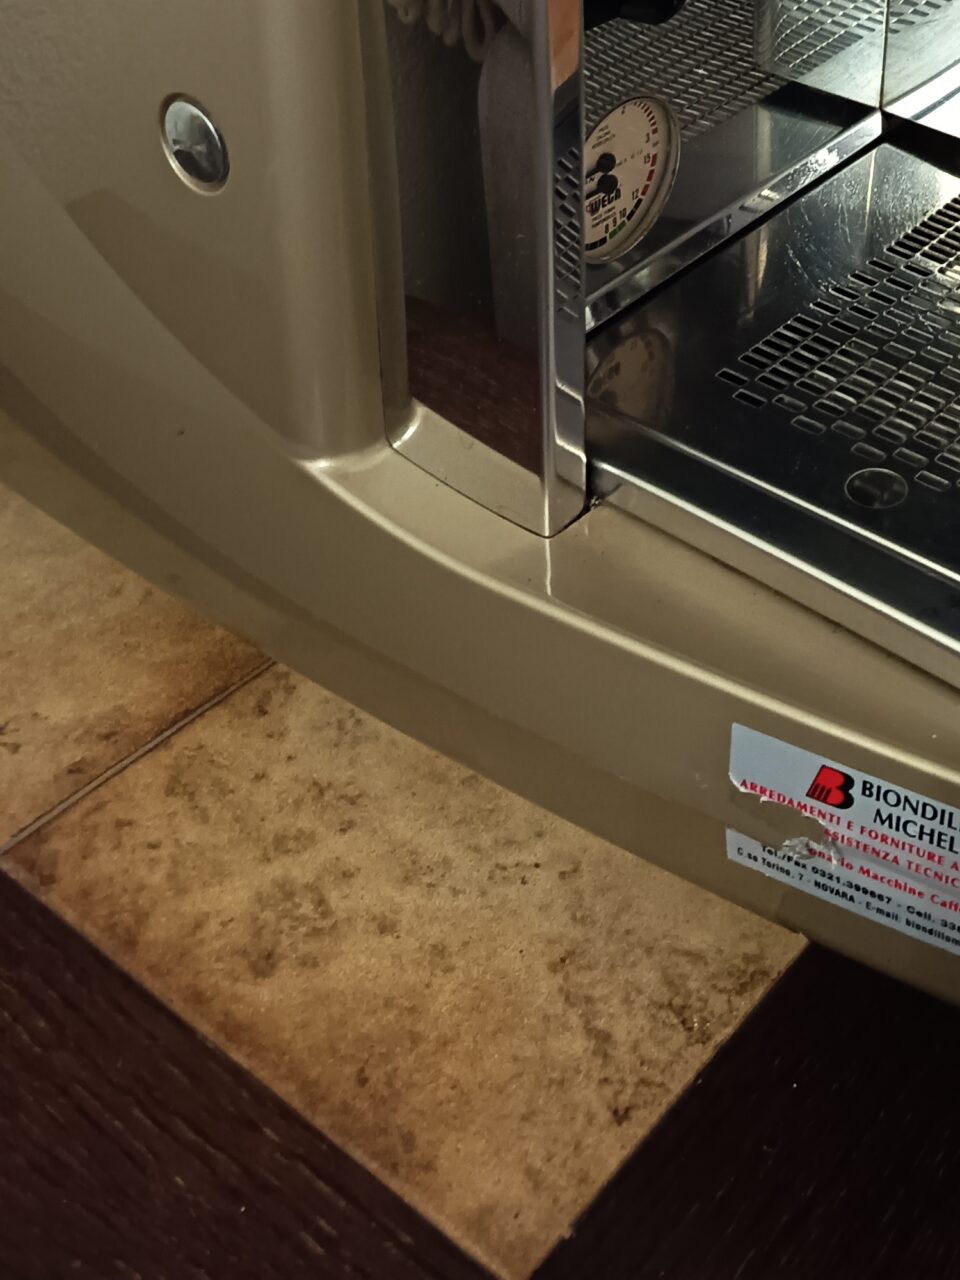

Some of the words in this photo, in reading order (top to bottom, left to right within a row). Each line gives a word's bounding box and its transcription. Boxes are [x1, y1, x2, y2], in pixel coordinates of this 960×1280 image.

[740, 778, 841, 826] ARREDAMENTI
[847, 820, 854, 831] E
[860, 825, 945, 866] FORNITURE
[814, 880, 855, 903] NOVARA
[858, 866, 925, 899] Macchine
